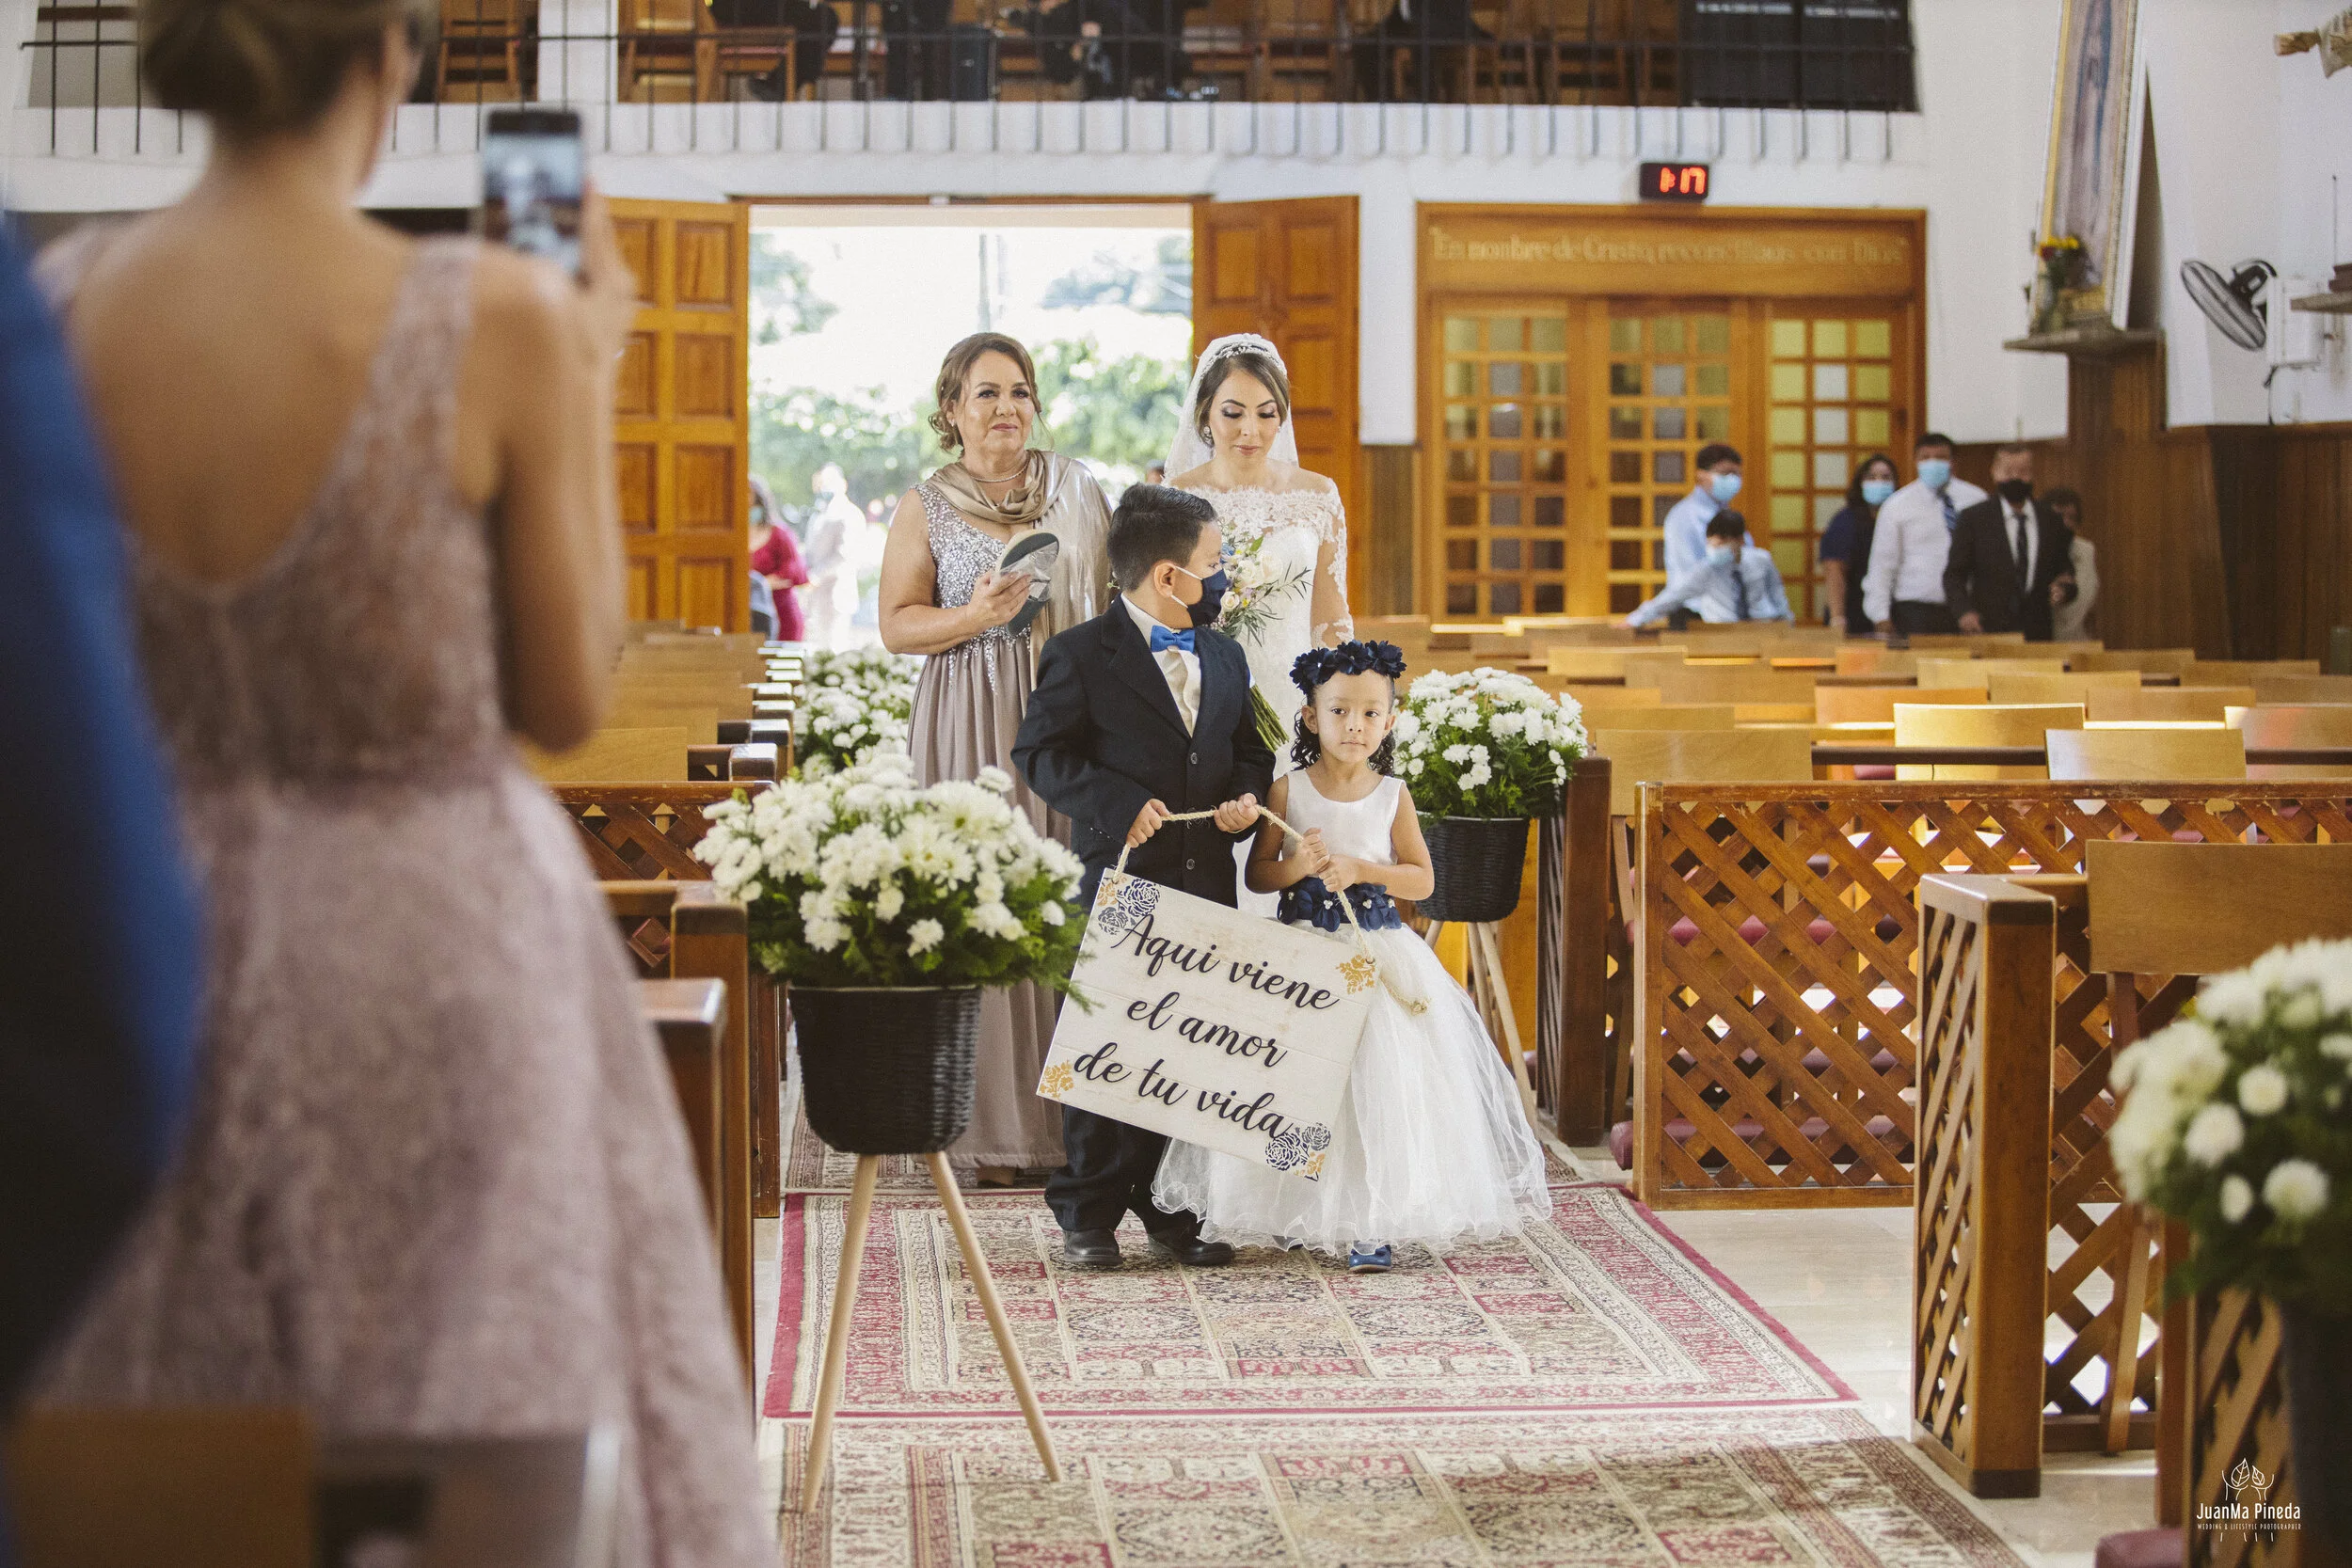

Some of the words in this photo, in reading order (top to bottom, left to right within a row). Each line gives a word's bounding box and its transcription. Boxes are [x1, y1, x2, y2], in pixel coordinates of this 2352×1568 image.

[1110, 914, 1221, 977] Aqui
[1229, 960, 1340, 1010] viene
[1127, 991, 1181, 1031] el
[1178, 1016, 1288, 1069] amor
[1073, 1041, 1132, 1085] de
[1138, 1058, 1188, 1106] tu
[1197, 1089, 1296, 1140] vida
